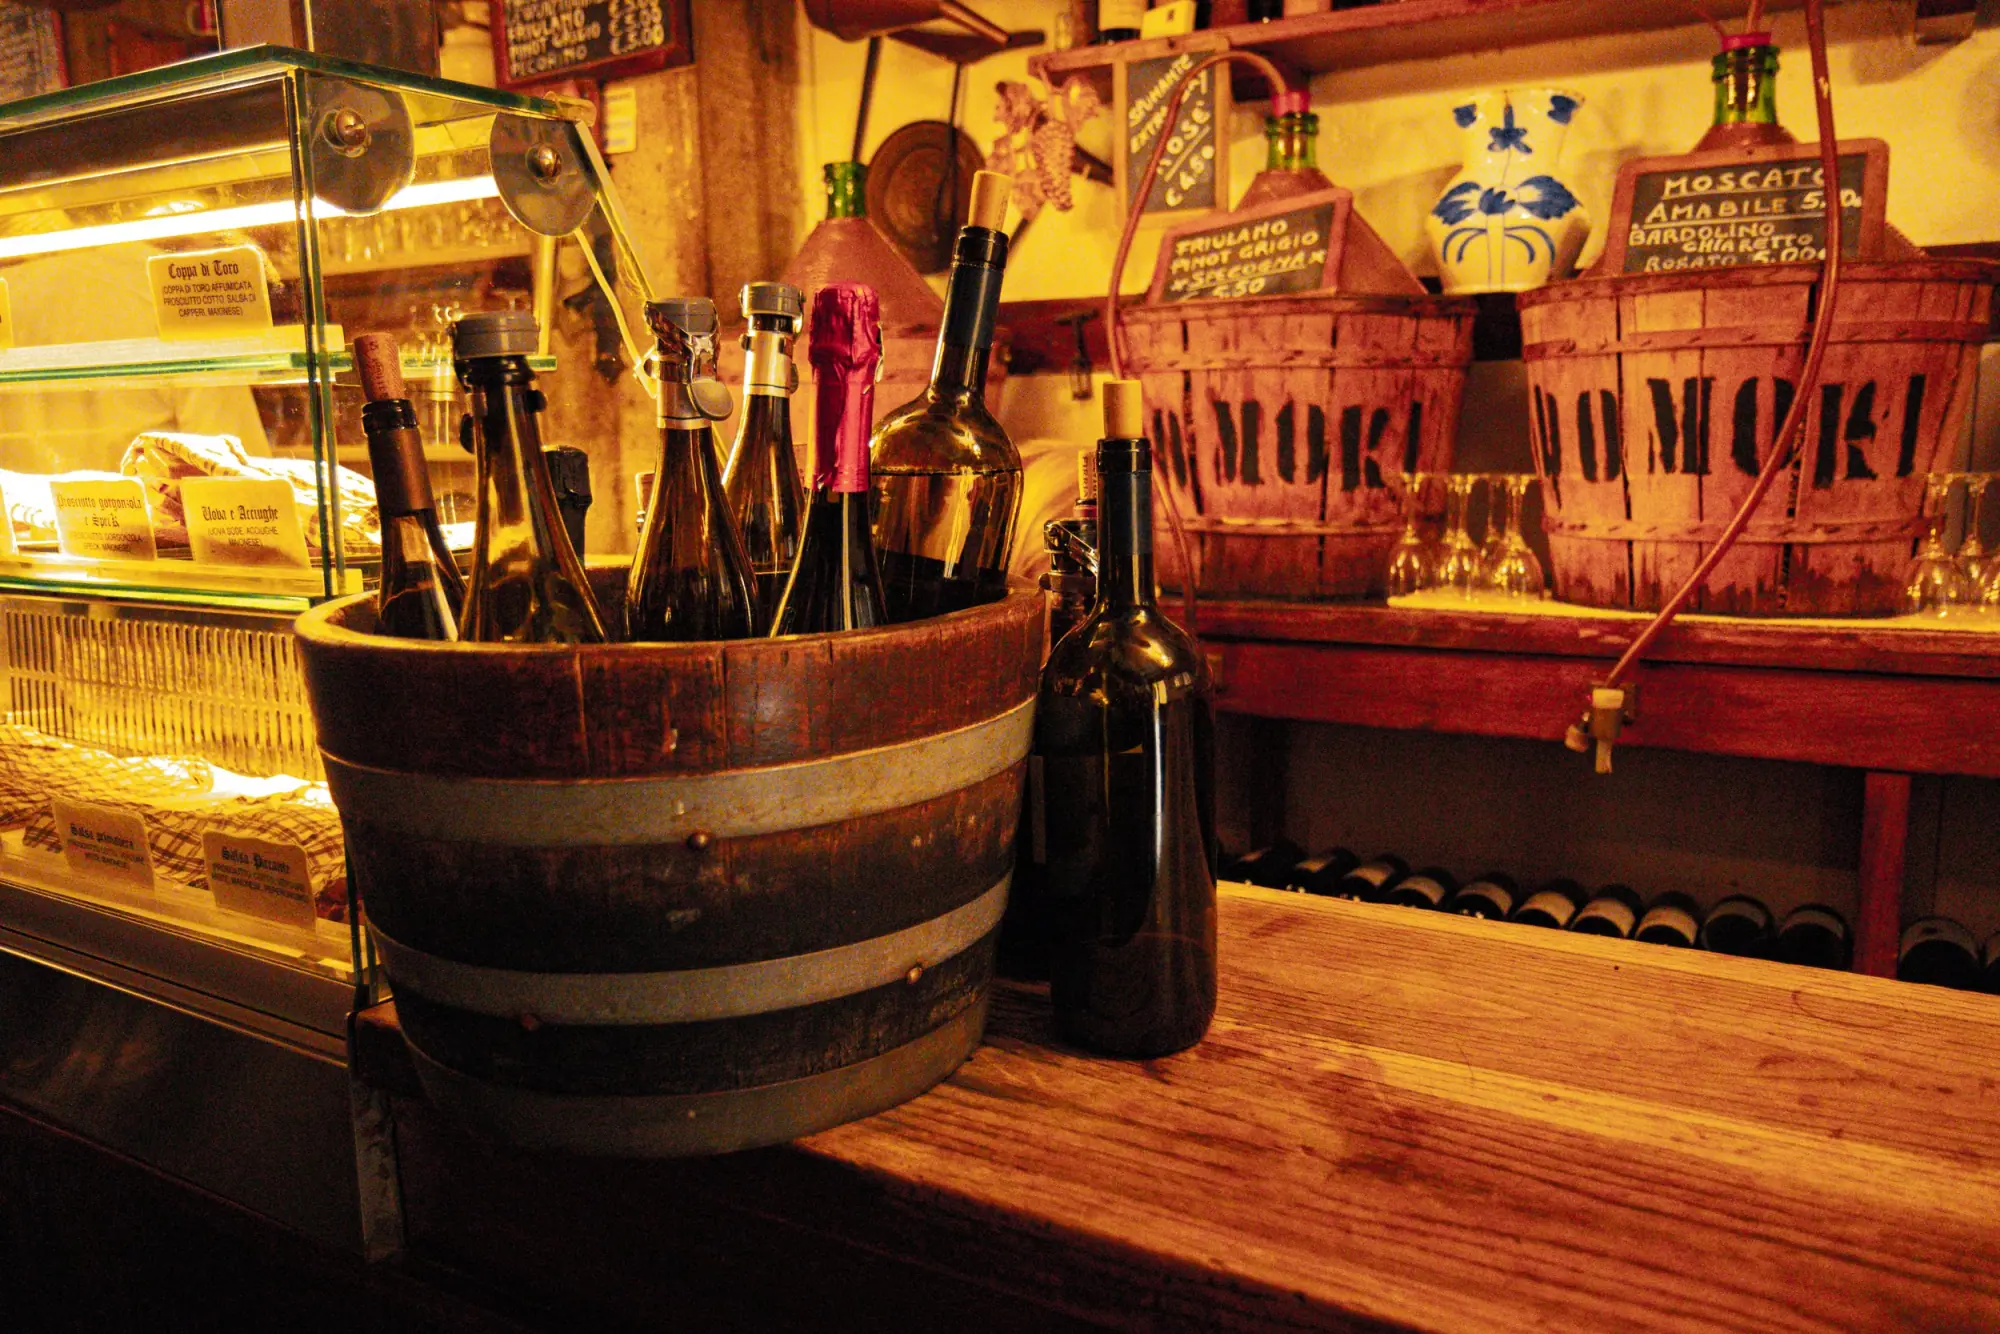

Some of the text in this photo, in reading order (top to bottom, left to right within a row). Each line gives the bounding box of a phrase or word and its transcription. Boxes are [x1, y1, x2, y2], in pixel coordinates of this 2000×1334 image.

[1645, 195, 1788, 224] AMABILE
[1175, 219, 1288, 257] FRIULANO
[1628, 221, 1776, 248] BARDOLINO
[1170, 230, 1319, 275] PINOT GRIGIO
[168, 263, 198, 280] Coppa
[214, 259, 240, 277] Toro
